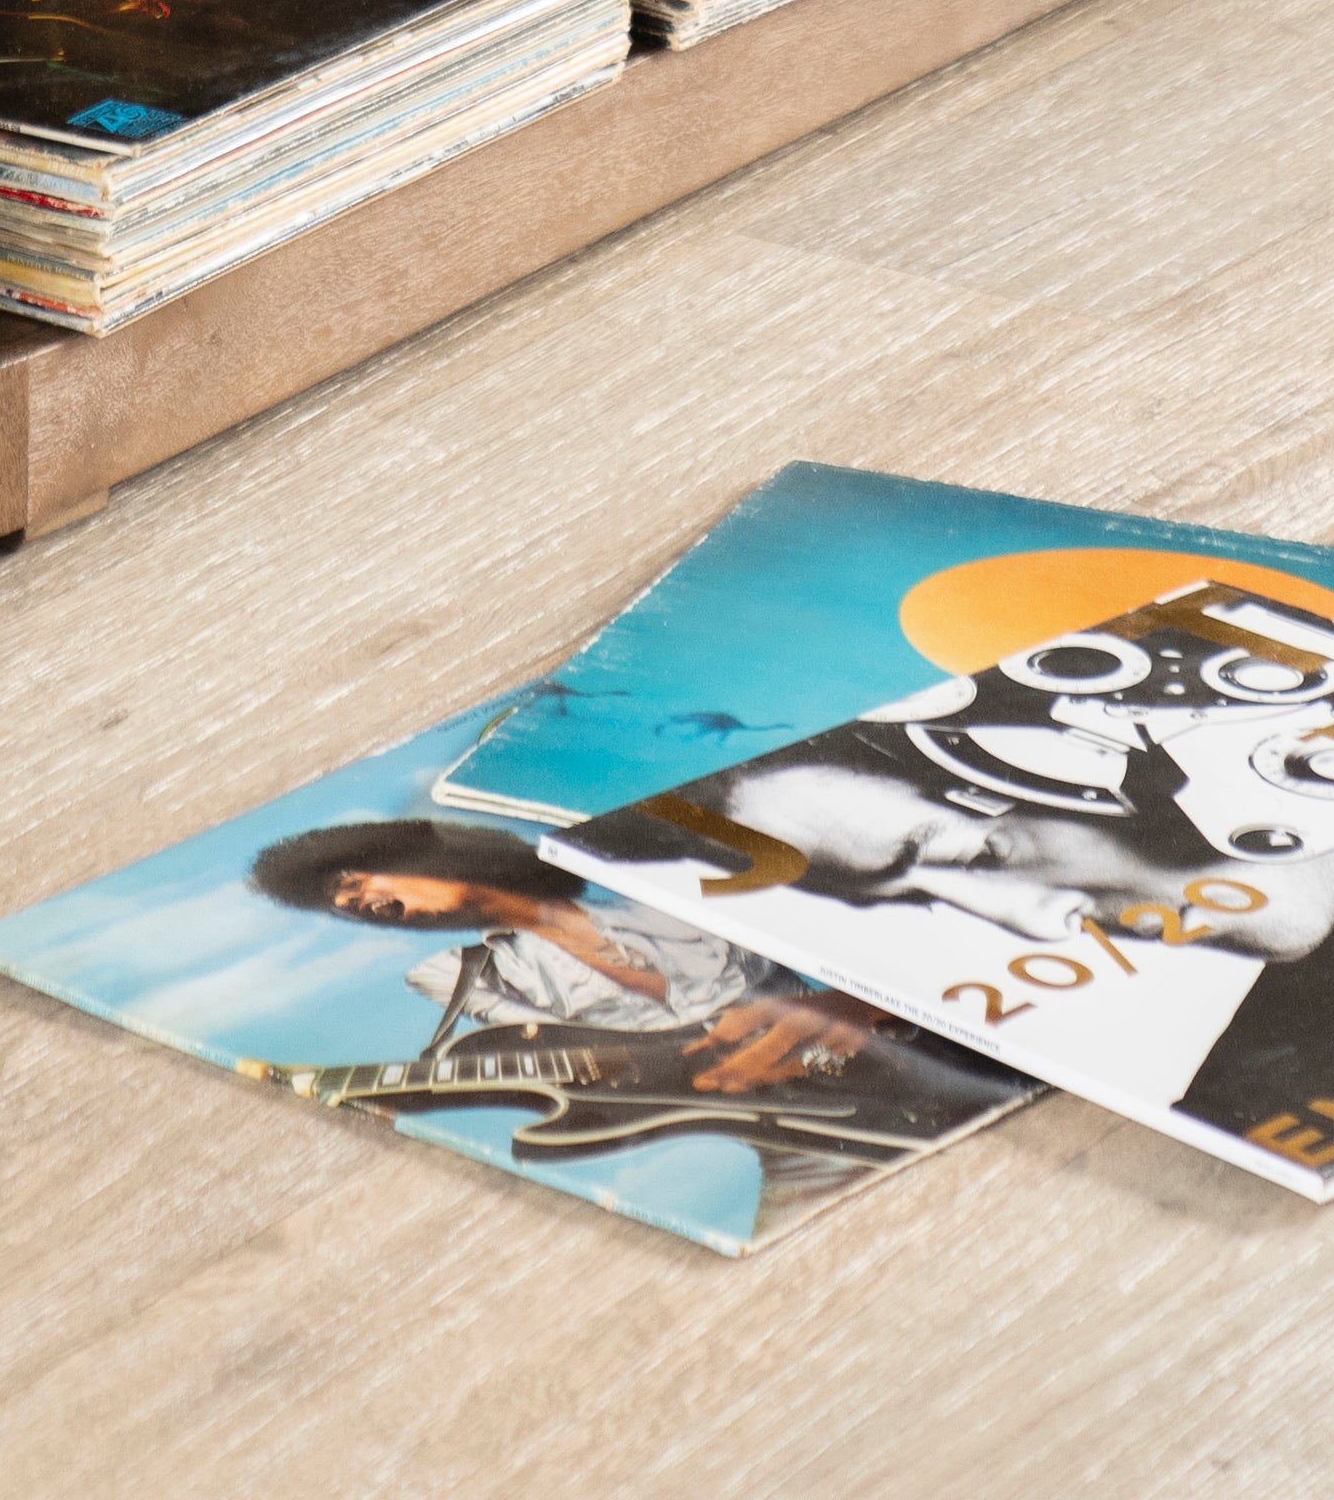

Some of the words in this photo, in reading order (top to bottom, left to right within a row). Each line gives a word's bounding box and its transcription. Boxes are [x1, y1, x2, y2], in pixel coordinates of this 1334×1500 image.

[819, 965, 847, 984] JUSTIN
[849, 977, 901, 1009] TIMBERLAKE
[903, 1002, 919, 1017] THE
[921, 1010, 947, 1030] 20/20
[948, 1022, 1001, 1055] EXPERIENCE
[942, 876, 1269, 1028] 20/20
